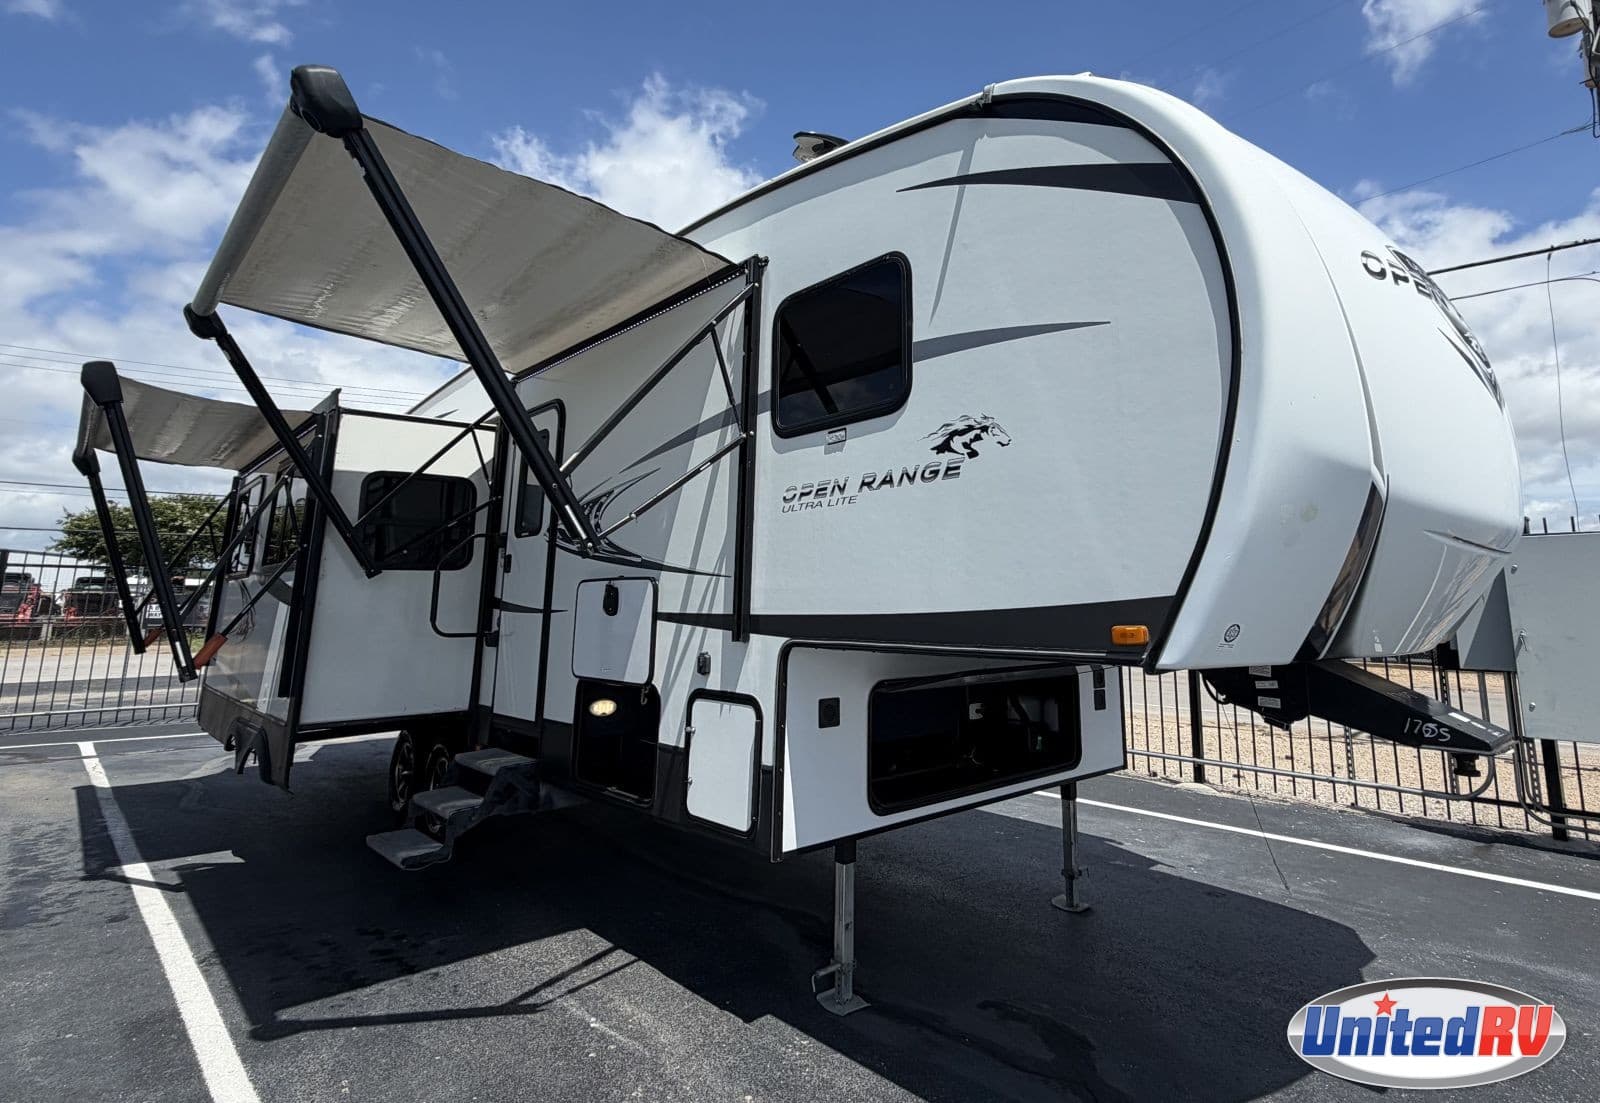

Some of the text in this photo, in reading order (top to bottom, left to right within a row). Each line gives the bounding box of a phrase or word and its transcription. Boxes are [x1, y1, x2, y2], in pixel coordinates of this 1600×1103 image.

[782, 457, 965, 503] OPEN RANGE
[781, 494, 859, 514] ULTRA LITE
